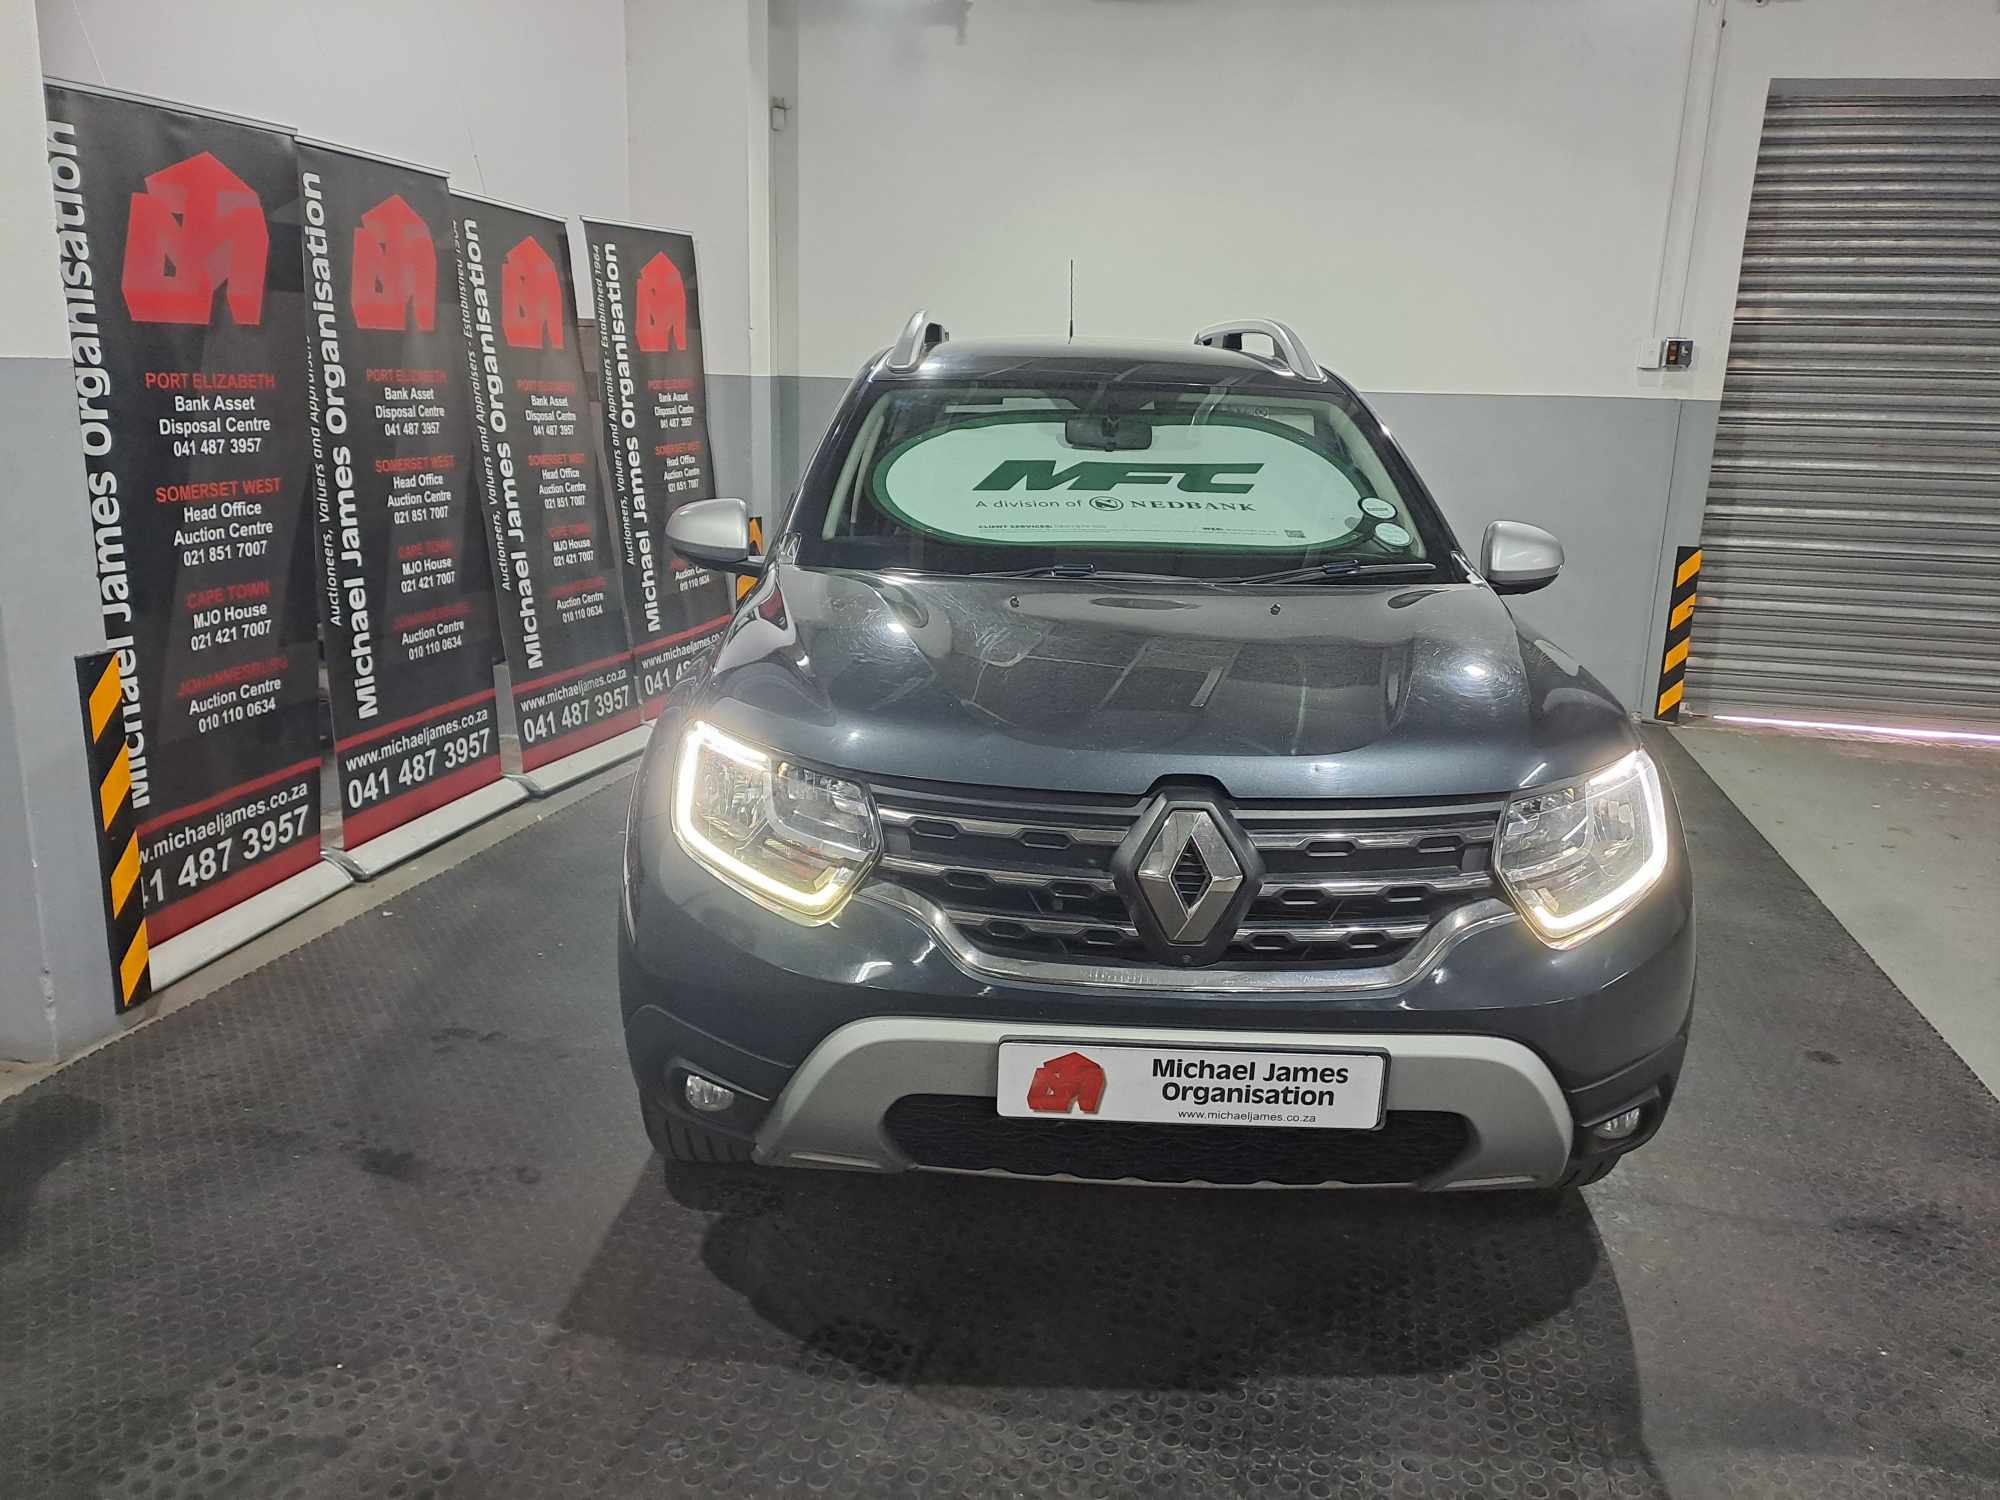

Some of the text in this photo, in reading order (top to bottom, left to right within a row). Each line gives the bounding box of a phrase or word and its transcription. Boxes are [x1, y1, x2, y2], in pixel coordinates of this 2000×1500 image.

[595, 279, 608, 348] Established
[145, 373, 276, 390] PORT ELIZABETH
[384, 387, 434, 400] Bank Asset
[467, 350, 488, 423] Appraisers
[600, 359, 617, 421] Appraisers
[175, 396, 255, 412] Bank Asset
[375, 405, 445, 421] Disposal Centre
[531, 395, 548, 406] Bank
[159, 417, 271, 435] Disposal Centre
[384, 424, 400, 436] 041
[403, 423, 418, 435] 487
[477, 425, 489, 453] and
[605, 243, 661, 632] Michael James Organisation
[609, 423, 620, 447] and
[173, 438, 262, 457] 041 487 3957
[302, 172, 378, 719] Michael James Organisation
[311, 426, 322, 459] and
[464, 219, 543, 670] Michael James Organisation
[393, 473, 444, 489] Head Office
[484, 456, 498, 505] Valuers
[614, 450, 625, 492] Valuers
[972, 460, 1265, 494] MFC
[156, 477, 282, 503] SOMERSET WEST
[315, 463, 330, 523] Valuers
[387, 491, 452, 507] Auction Centre
[184, 501, 262, 523] Head Office
[394, 506, 449, 524] 021 851 7007
[976, 499, 1256, 511] A division of NEDBANK
[173, 520, 273, 546] Auction Centre
[569, 538, 591, 549] House
[620, 496, 635, 565] Auctioneers,
[88, 471, 132, 623] James
[183, 541, 268, 567] 021 851 7007
[492, 511, 511, 591] Auctioneers,
[322, 529, 342, 626] Auctioneers,
[402, 557, 452, 575] MJO House
[228, 581, 270, 600] TOWN
[401, 571, 456, 593] 021 421 7007
[193, 602, 267, 629] MJO House
[556, 596, 581, 610] Auction
[191, 620, 272, 651] 021 421 7007
[402, 620, 465, 645] Auction Centre
[408, 647, 423, 660] 010
[425, 640, 440, 655] 110
[520, 668, 626, 713] www.michaeljames.co.za
[645, 668, 671, 695] 041
[189, 679, 281, 715] Auction Centre
[199, 697, 276, 733] 010 110 0634
[523, 684, 629, 743] 041 487 3957
[346, 709, 488, 772] www.michaeljames.co.za
[348, 728, 490, 808] 041 487 3957
[178, 804, 309, 887] 487 3957
[1152, 1058, 1349, 1084] Michael James
[1162, 1081, 1335, 1107] Organisation
[1178, 1110, 1316, 1124] www.michaeljames.co.za
